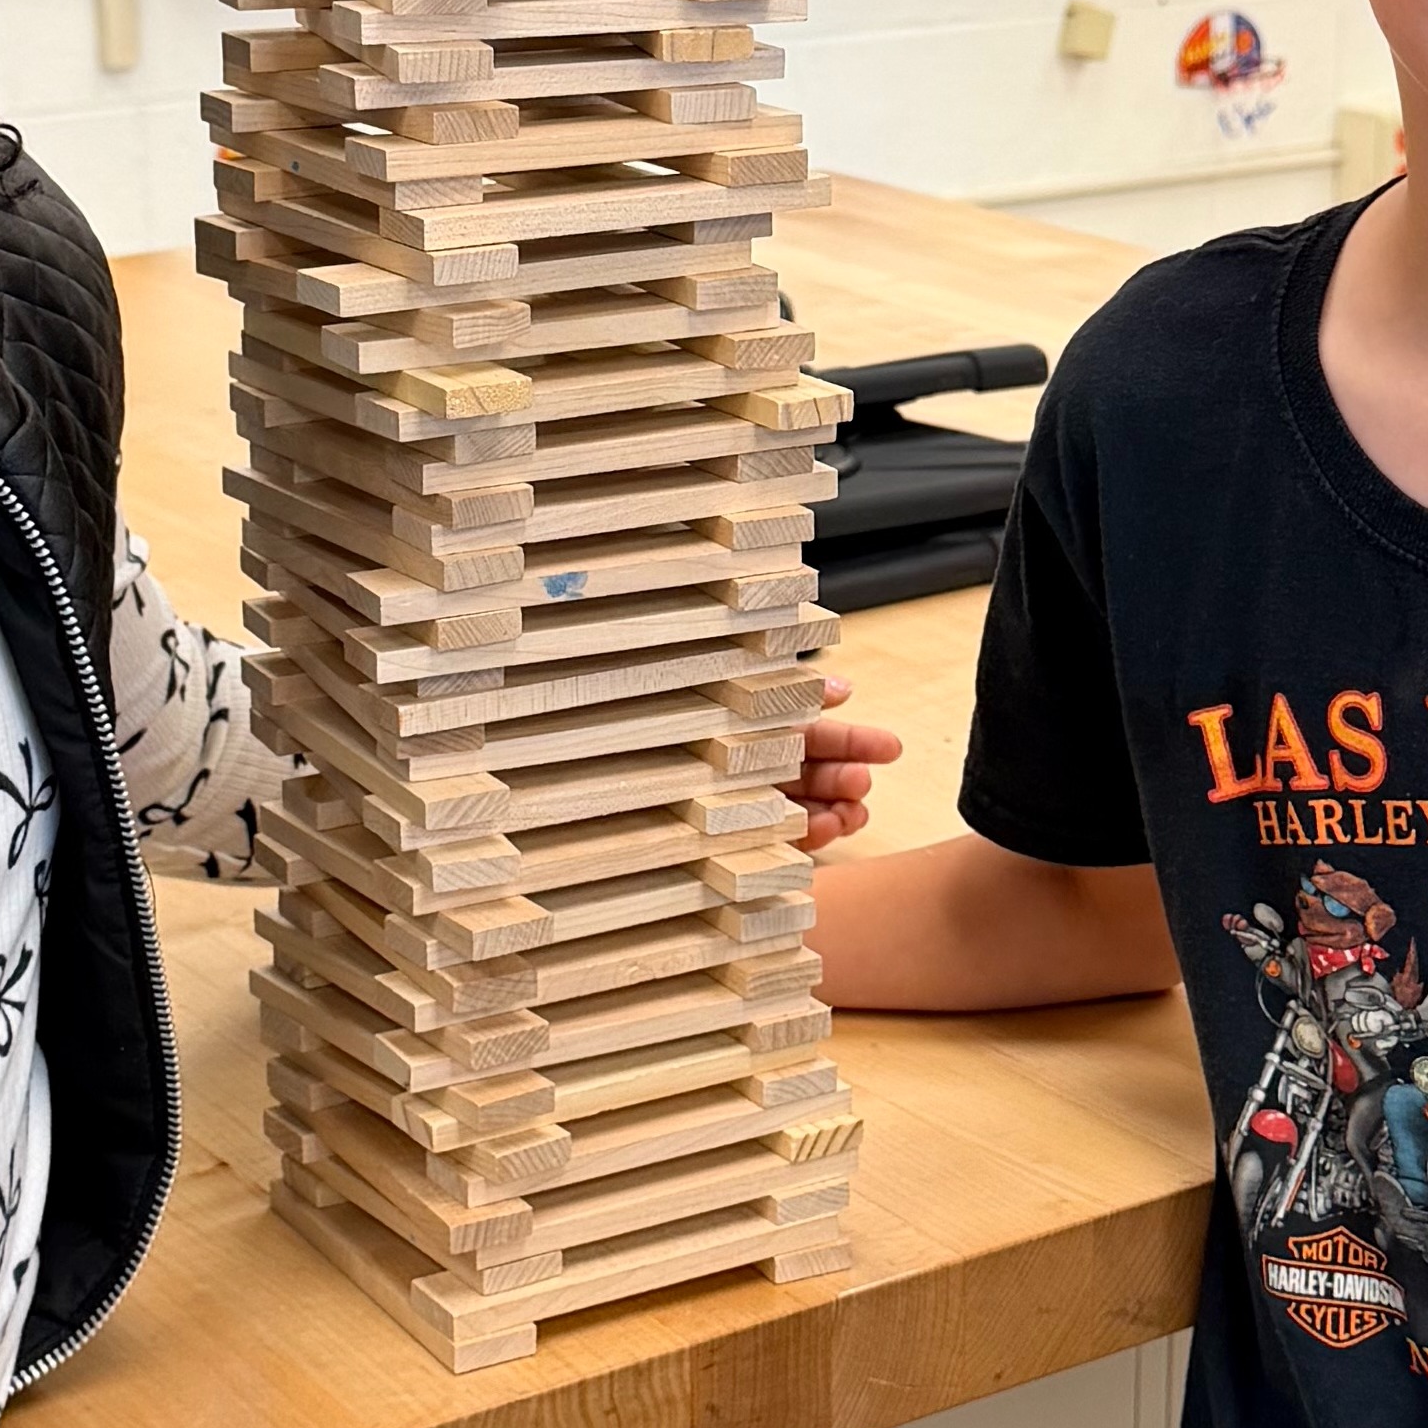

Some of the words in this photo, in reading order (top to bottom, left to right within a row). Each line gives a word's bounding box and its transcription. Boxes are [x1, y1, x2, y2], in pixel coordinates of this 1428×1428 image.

[1187, 689, 1388, 803] LAS
[1301, 1233, 1378, 1269] MOTOR
[1299, 1303, 1378, 1341] CYCLES
